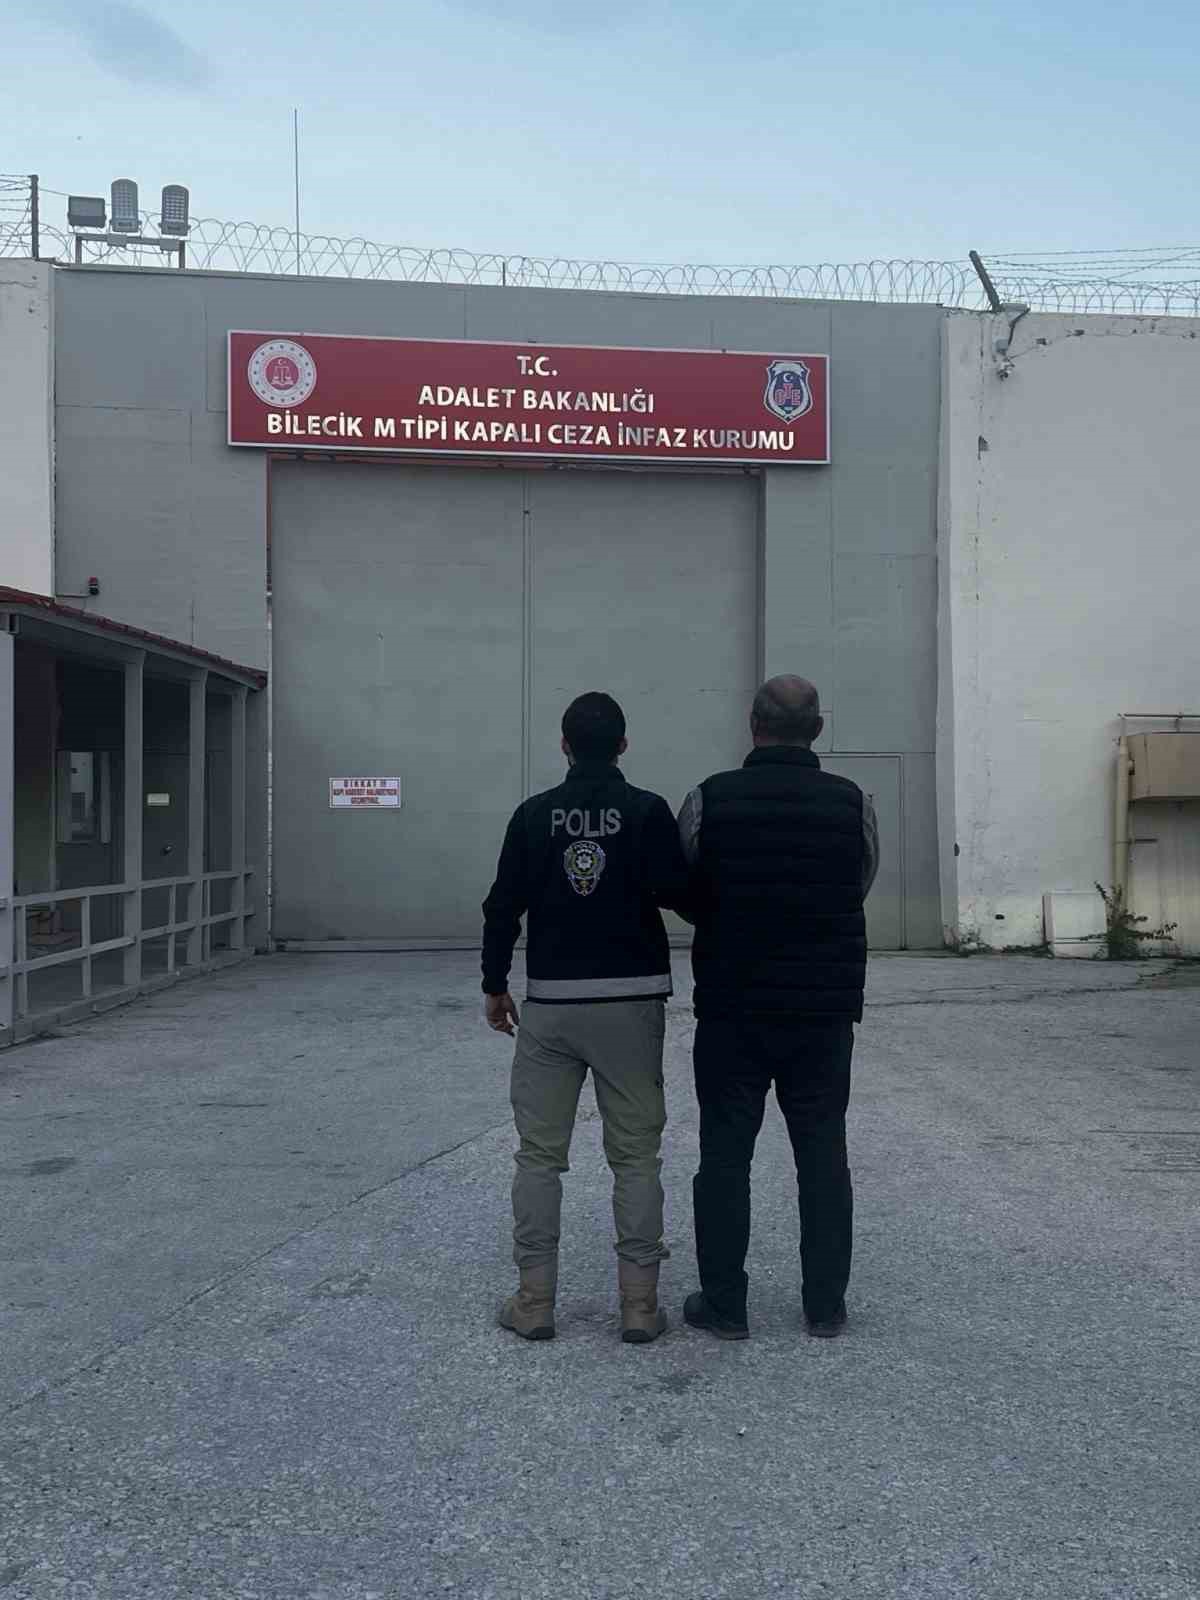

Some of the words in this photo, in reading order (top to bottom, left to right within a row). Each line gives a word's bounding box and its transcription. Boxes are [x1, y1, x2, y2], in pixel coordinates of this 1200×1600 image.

[516, 355, 558, 377] T.C.
[418, 385, 517, 409] ADALET
[523, 388, 655, 414] BAKANLIĞI
[267, 410, 364, 438] BİLECİK
[374, 417, 396, 439] M
[400, 415, 448, 441] TİPİ
[454, 420, 541, 444] KAPALI
[547, 424, 612, 446] CEZA
[618, 421, 688, 448] İNFAZ
[693, 428, 795, 451] KURUMU
